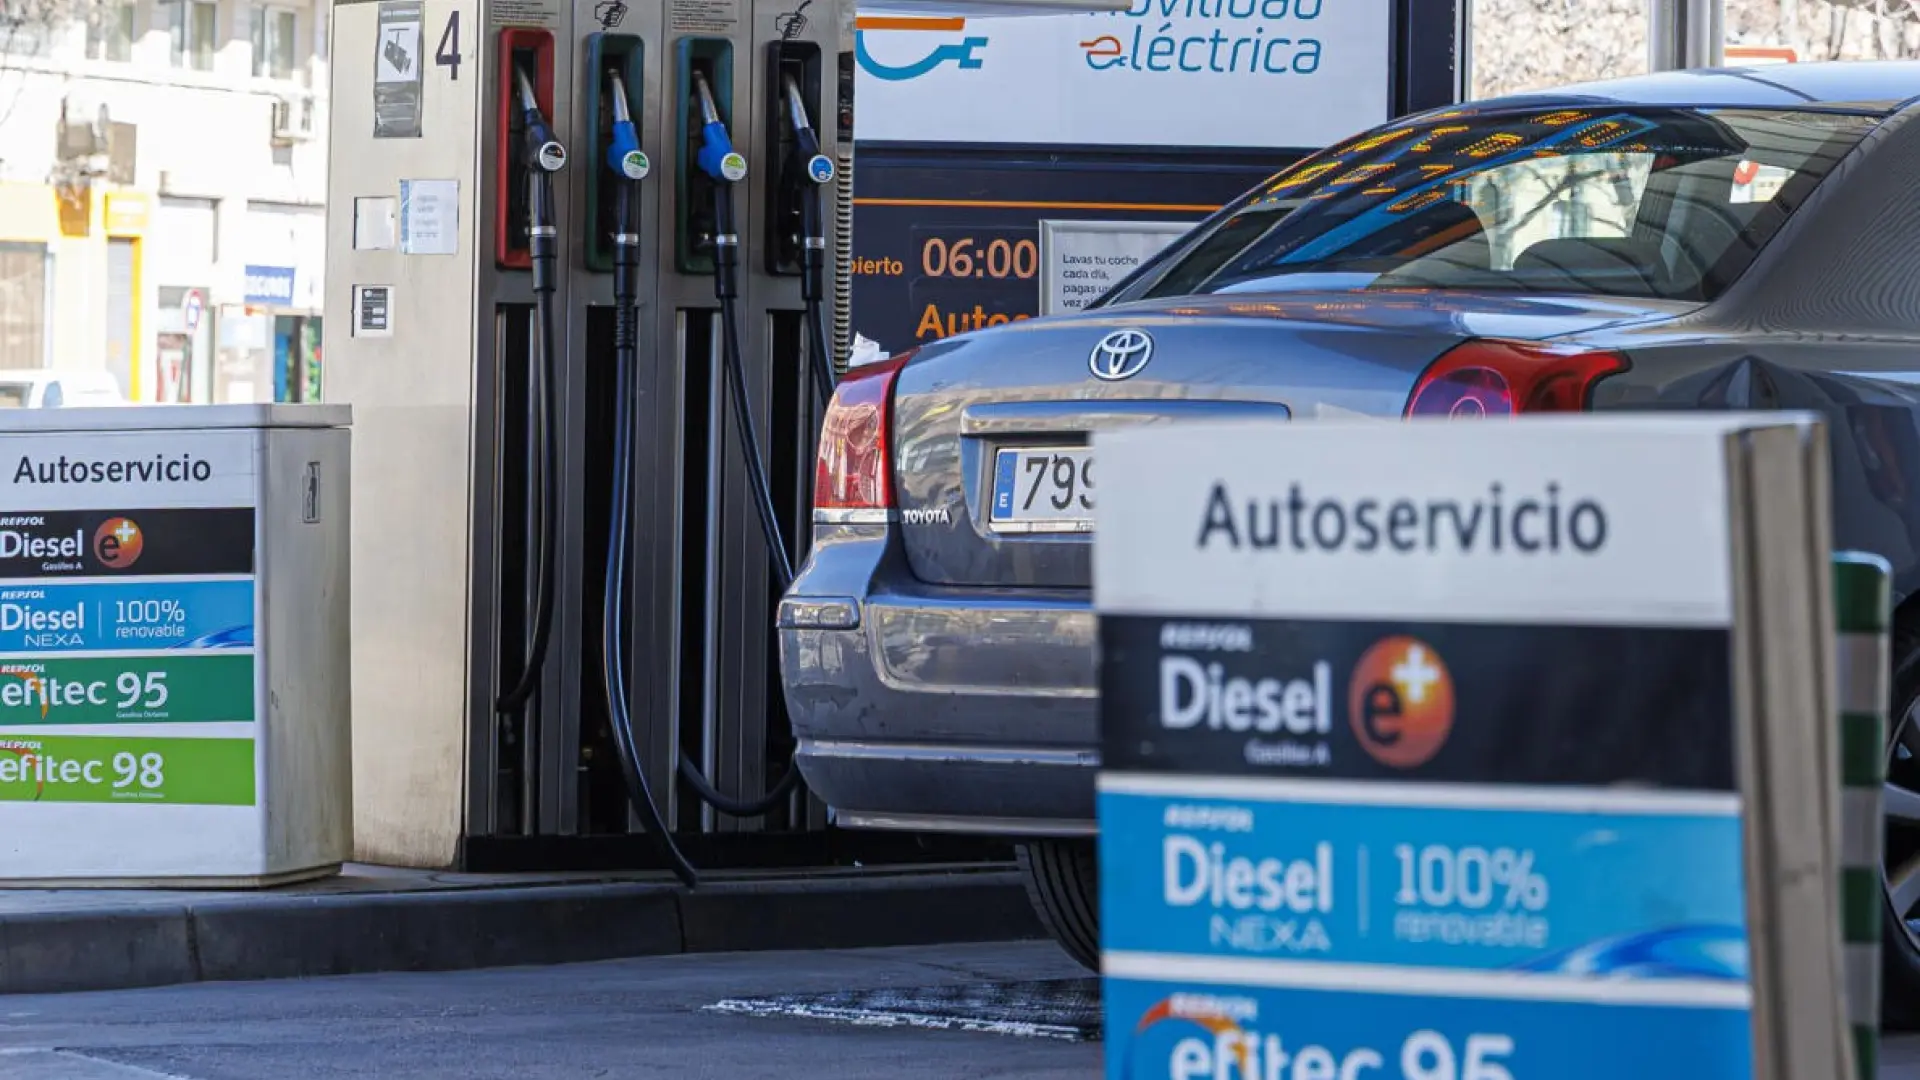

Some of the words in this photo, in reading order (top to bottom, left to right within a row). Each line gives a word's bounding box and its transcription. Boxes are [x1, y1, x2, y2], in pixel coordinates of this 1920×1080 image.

[435, 11, 461, 80] 4
[1079, 22, 1322, 74] eléctrica
[922, 238, 1037, 279] 06:00
[1062, 253, 1093, 264] Lavas
[1094, 255, 1106, 265] tu
[1108, 254, 1139, 265] coche
[1062, 269, 1089, 279] cada
[1062, 284, 1097, 296] pagas
[1062, 299, 1082, 308] vez
[13, 453, 212, 484] Autoservicio
[999, 492, 1010, 508] E
[903, 509, 950, 525] TOYOTA
[1197, 480, 1609, 554] Autoservicio
[0, 529, 83, 559] Diesel
[1, 602, 85, 631] Diesel
[116, 599, 186, 624] 100%
[24, 633, 84, 648] NEXA
[116, 624, 186, 639] renovable
[1, 677, 108, 707] efitec
[116, 671, 169, 709] 95
[1160, 655, 1332, 733] Diesel
[0, 754, 104, 784] efitec
[112, 751, 165, 789] 98
[1163, 834, 1334, 913] Diesel
[1393, 842, 1550, 912] 100%
[1209, 913, 1332, 953] NEXA
[1394, 910, 1550, 949] renovable
